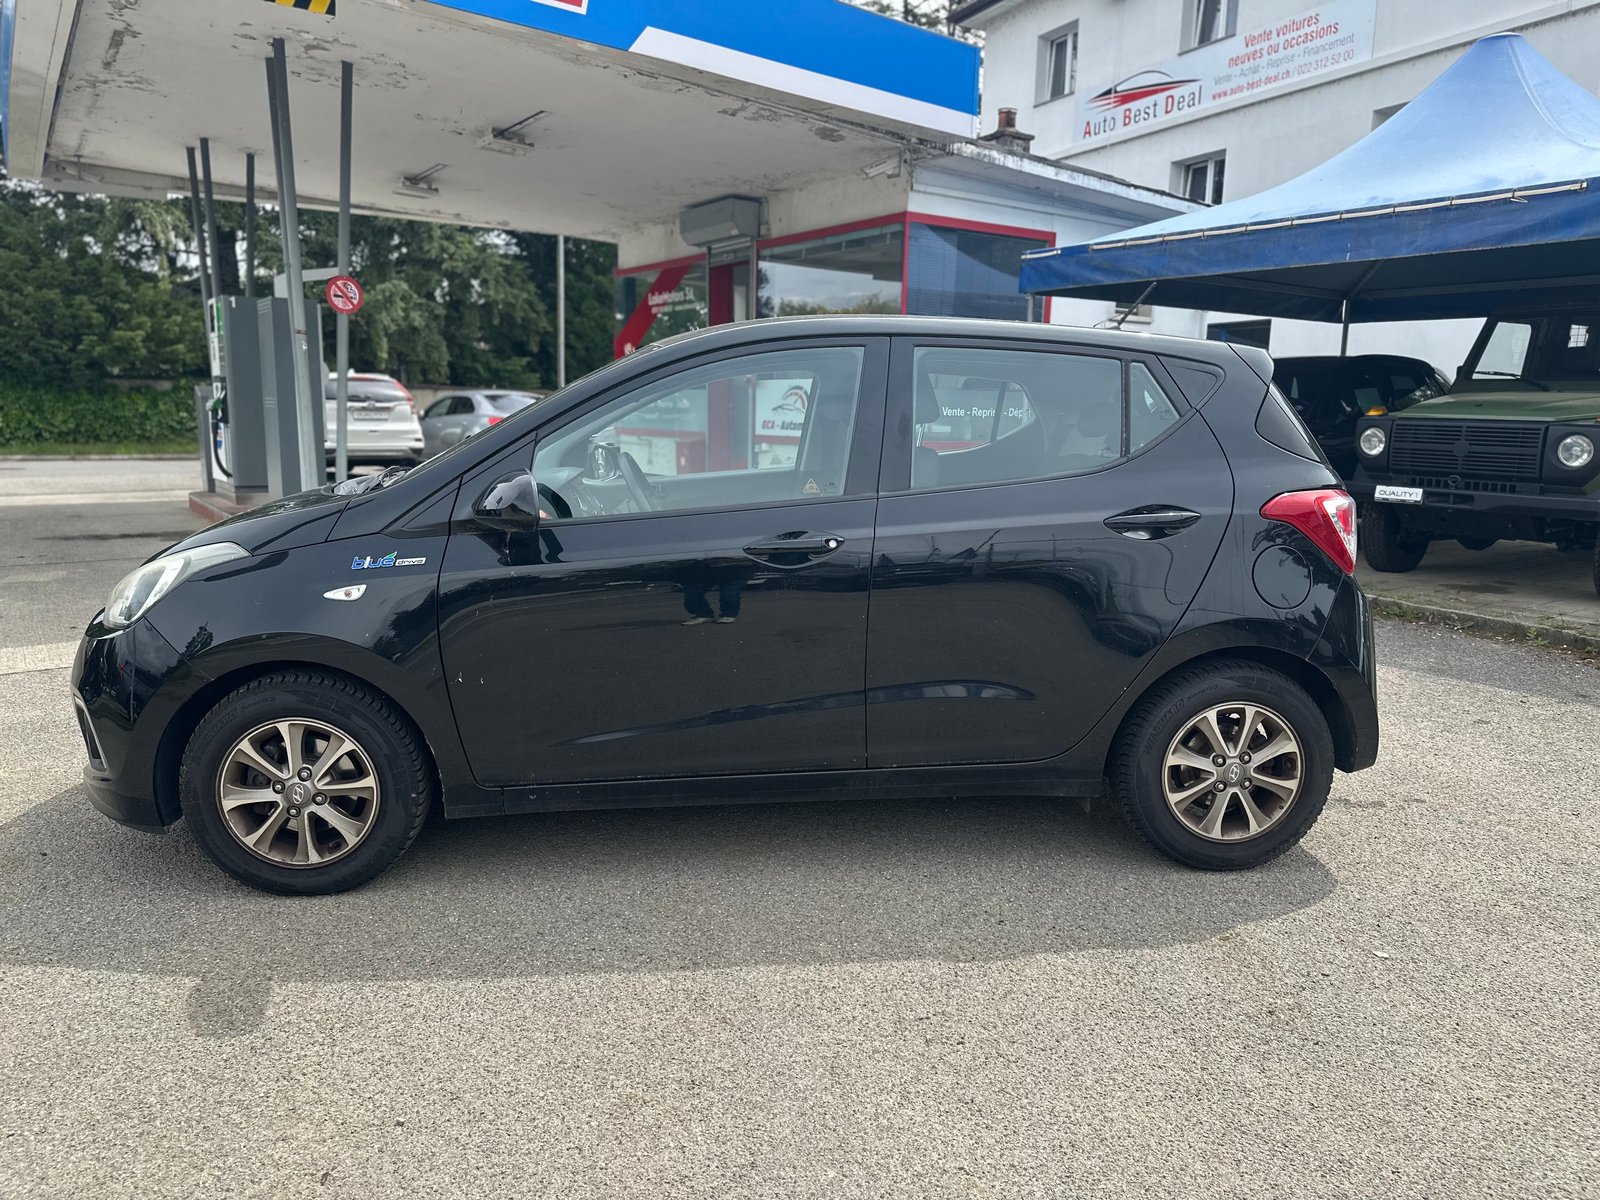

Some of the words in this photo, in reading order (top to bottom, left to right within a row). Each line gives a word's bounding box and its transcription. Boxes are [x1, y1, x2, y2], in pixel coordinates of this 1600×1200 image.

[1244, 29, 1273, 48] Vente
[1276, 13, 1320, 38] voitures
[1228, 47, 1264, 69] neuves
[1267, 42, 1280, 56] ou
[1283, 22, 1339, 51] occasions
[1266, 53, 1295, 71] Reprise
[1302, 33, 1355, 58] Financement
[1212, 69, 1291, 101] www.auto-best-deal.ch
[1296, 63, 1313, 76] 022
[1313, 58, 1329, 71] 312
[1331, 53, 1341, 66] 52
[1343, 48, 1354, 61] 00
[1083, 115, 1116, 139] Auto
[1123, 99, 1158, 127] Best
[1164, 85, 1202, 115] Deal
[229, 296, 236, 308] 1
[942, 406, 965, 417] Vente
[971, 407, 1000, 419] Repris
[780, 420, 803, 431] Autom
[1378, 489, 1414, 498] QUALITY
[351, 555, 396, 570] blue
[397, 558, 424, 566] drive
